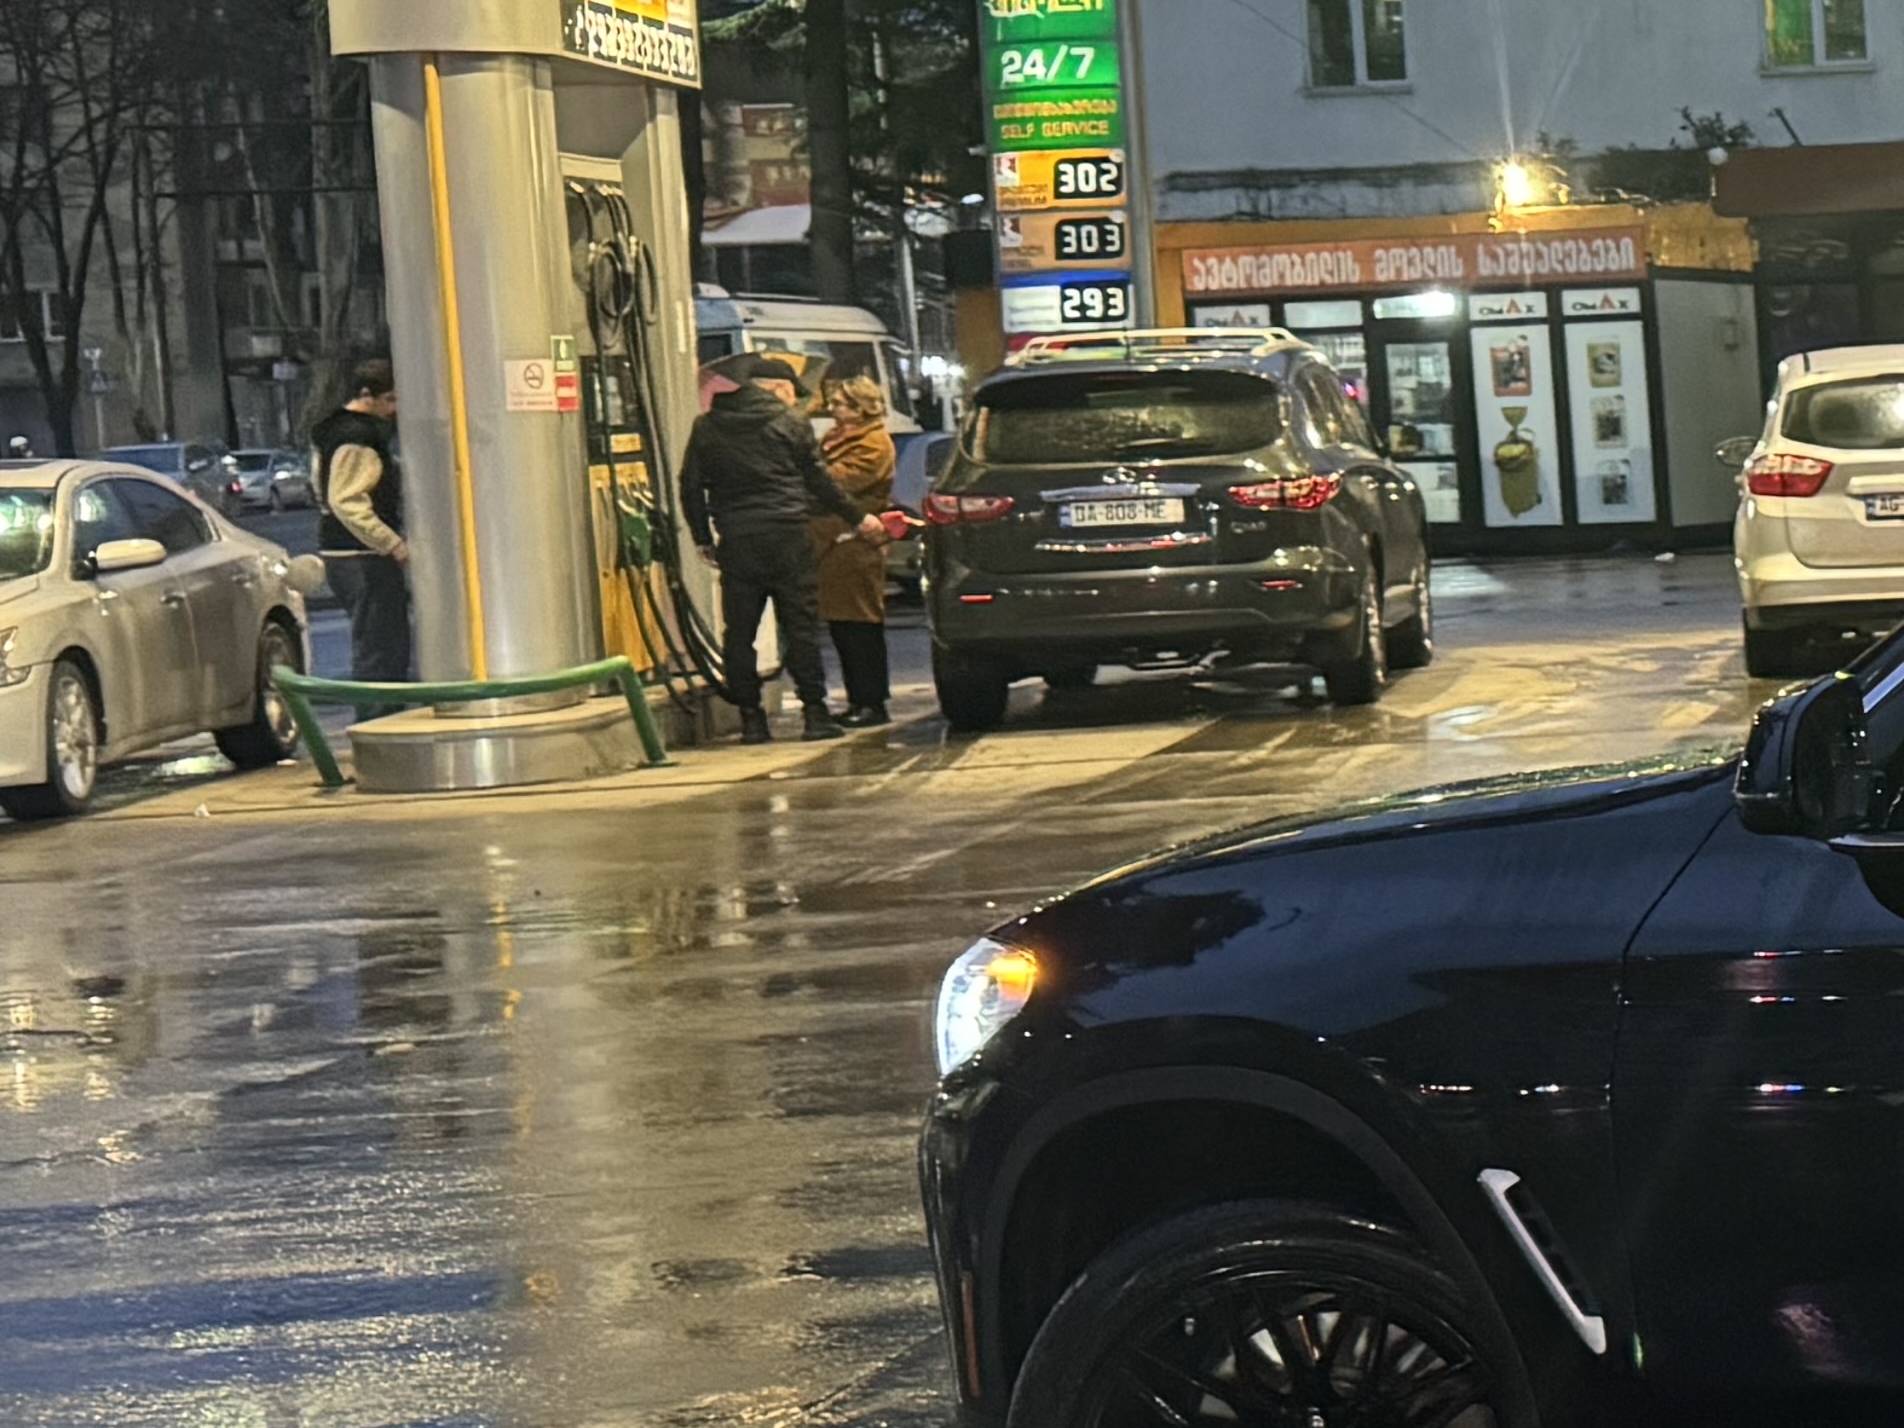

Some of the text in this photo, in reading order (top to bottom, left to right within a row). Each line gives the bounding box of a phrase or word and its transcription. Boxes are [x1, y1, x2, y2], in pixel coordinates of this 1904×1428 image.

[1001, 44, 1095, 84] 24/7
[1042, 119, 1111, 137] SERVICE
[1058, 162, 1119, 194] 302
[1061, 223, 1122, 254] 303
[1192, 235, 1636, 292] ავტომობილის მოვლის საშუალებები
[1063, 286, 1125, 319] 293
